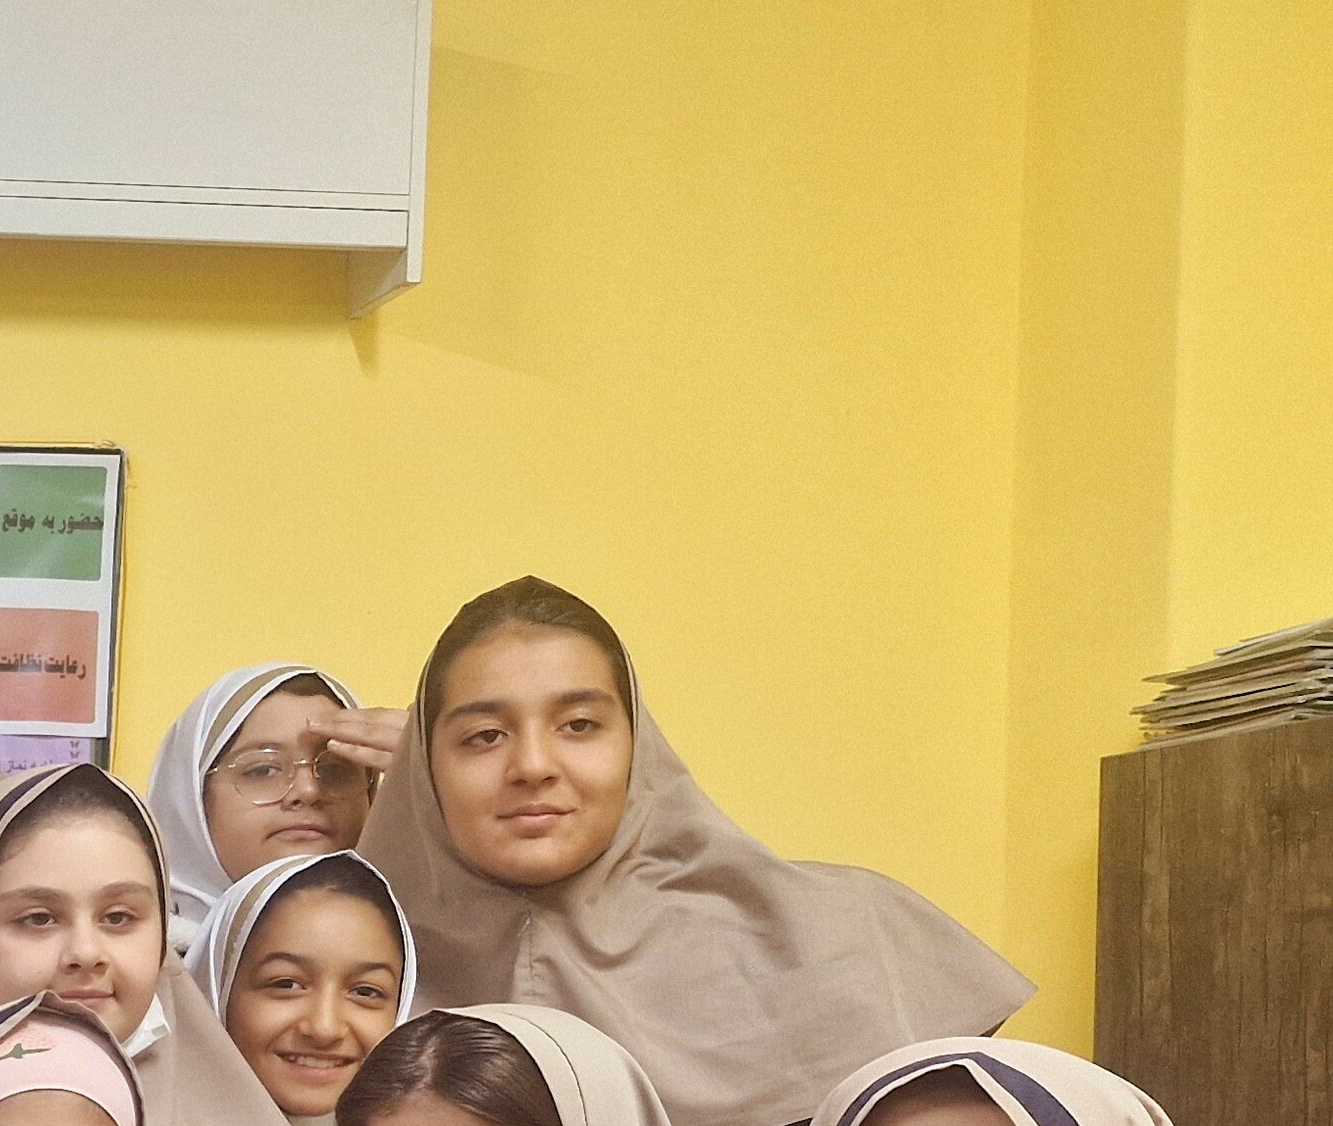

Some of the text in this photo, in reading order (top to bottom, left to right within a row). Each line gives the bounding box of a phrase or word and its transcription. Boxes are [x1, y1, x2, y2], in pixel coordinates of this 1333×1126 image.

[2, 508, 104, 534] حضور به موقع
[44, 655, 87, 679] رعایت
